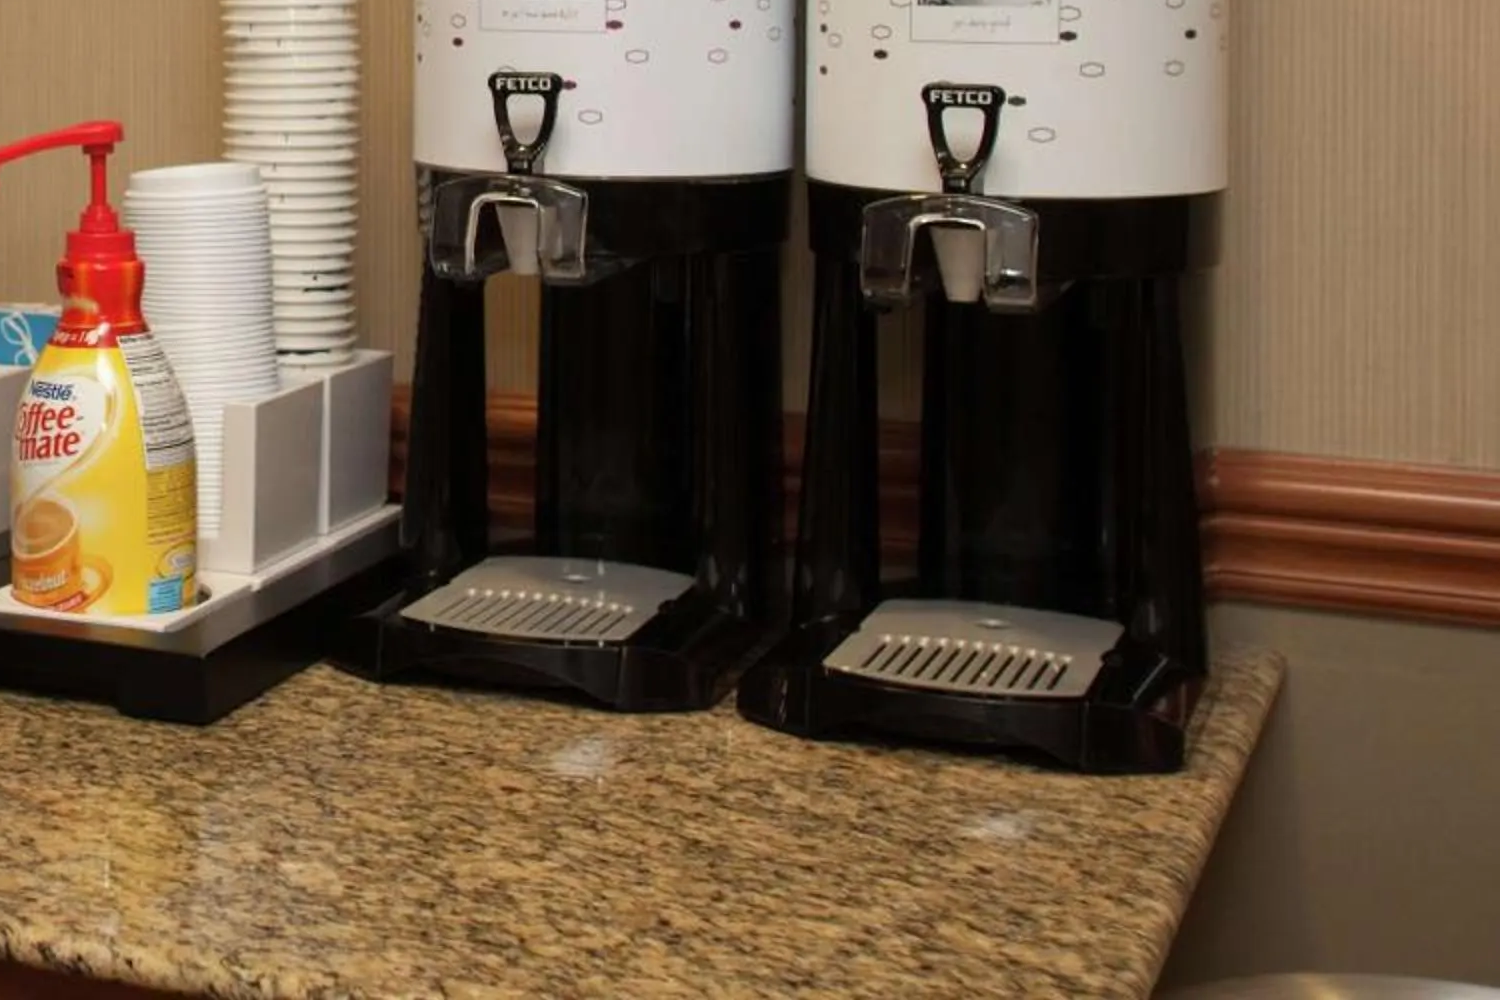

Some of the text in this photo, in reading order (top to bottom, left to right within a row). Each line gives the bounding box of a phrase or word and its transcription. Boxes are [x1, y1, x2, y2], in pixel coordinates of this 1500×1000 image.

[495, 77, 552, 91] FETCO
[930, 88, 993, 105] FETCO
[18, 430, 82, 461] mate
